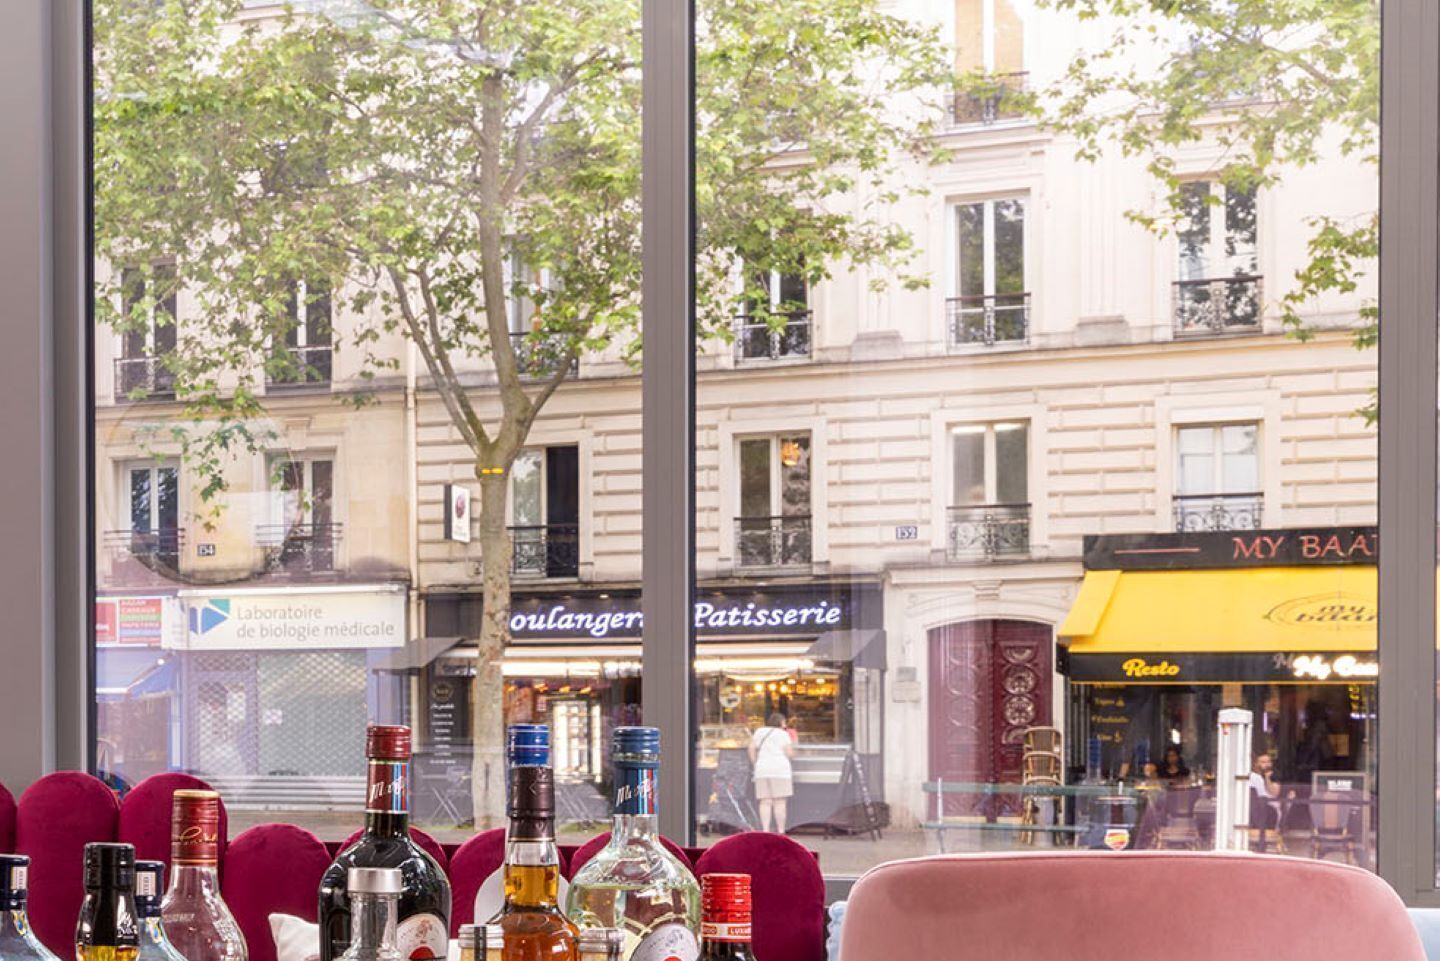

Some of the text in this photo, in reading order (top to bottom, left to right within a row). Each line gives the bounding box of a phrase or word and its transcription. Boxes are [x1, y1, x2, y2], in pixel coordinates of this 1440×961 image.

[1232, 536, 1284, 560] MY
[237, 605, 324, 620] Laboratoire
[510, 606, 643, 636] oulanger
[695, 602, 841, 627] Patisserie
[236, 621, 395, 642] de biologie médicale
[1122, 658, 1180, 677] Resto
